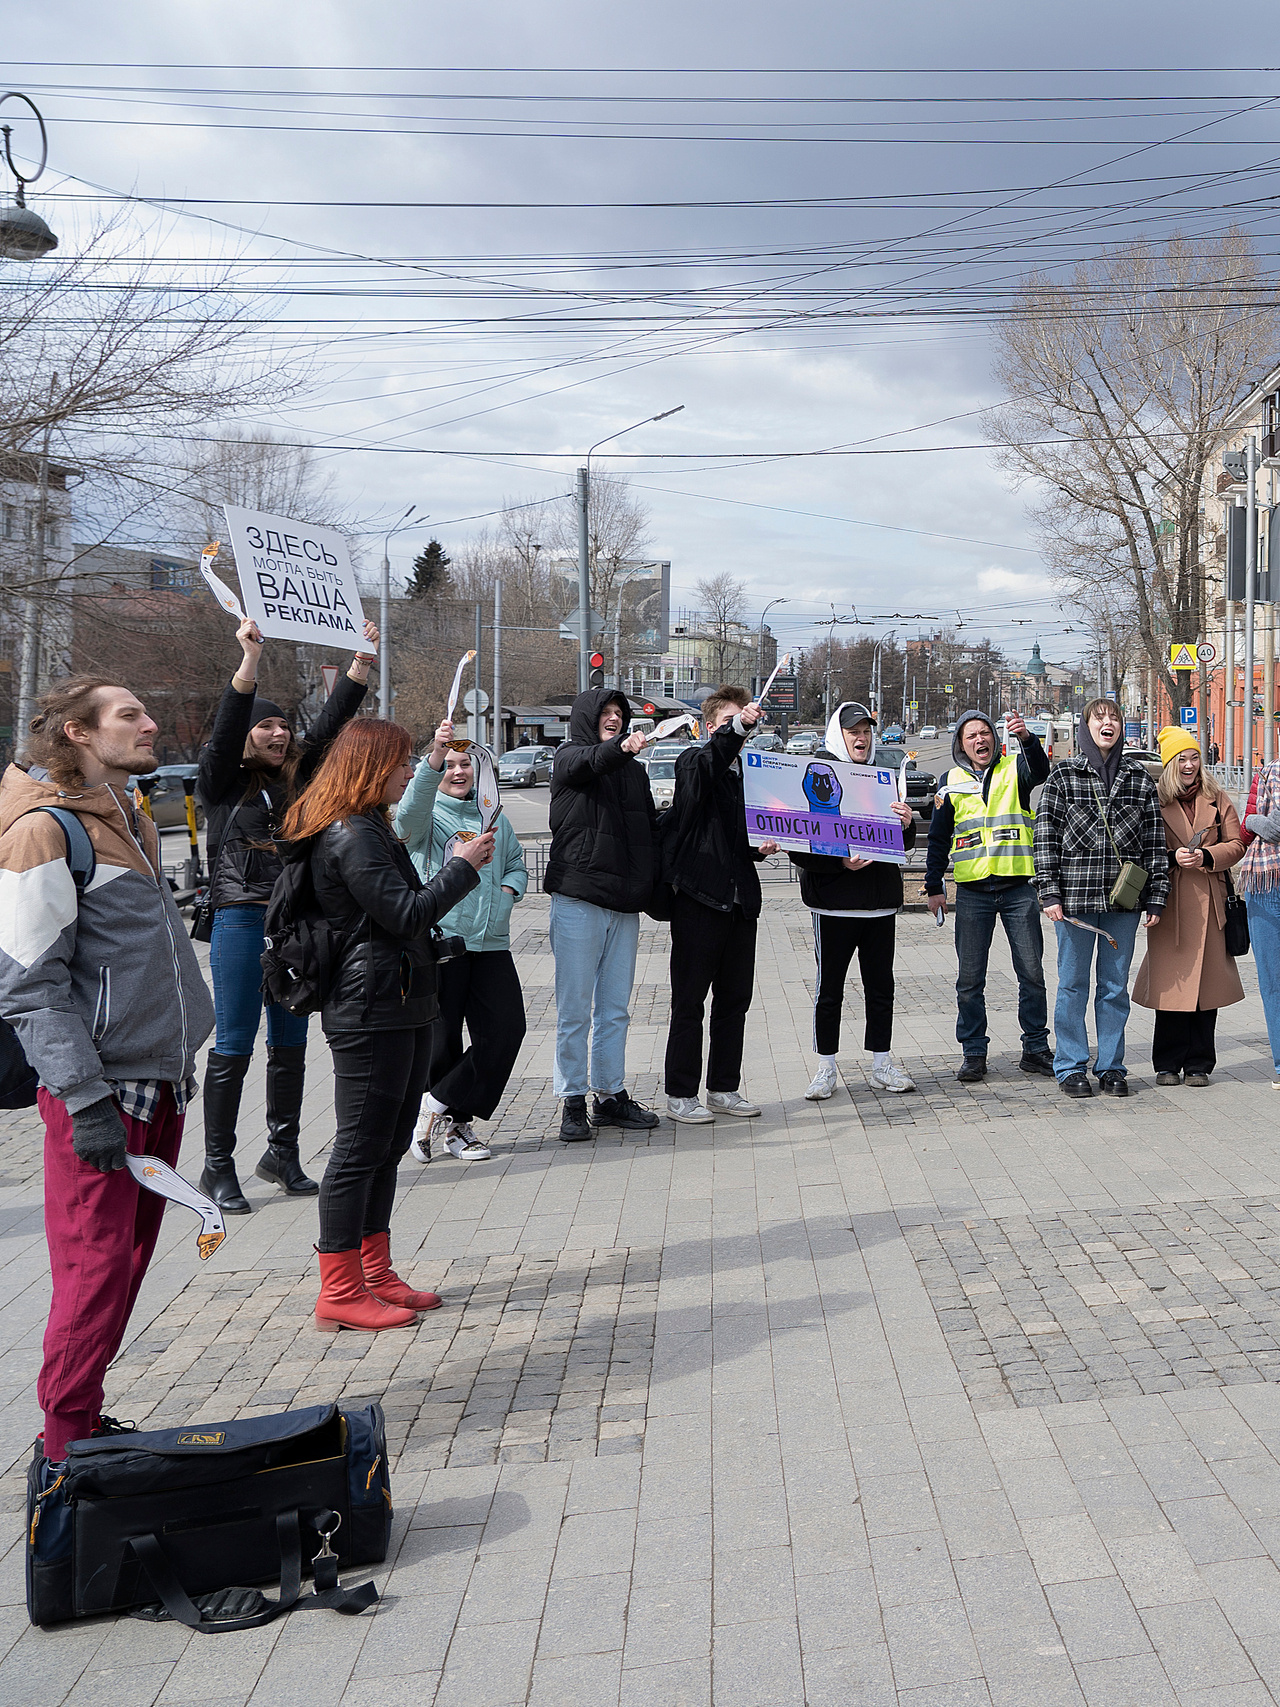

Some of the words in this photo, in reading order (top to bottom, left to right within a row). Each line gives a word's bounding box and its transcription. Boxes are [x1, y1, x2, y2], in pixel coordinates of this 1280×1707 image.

[246, 526, 338, 566] ЗДЕСЬ
[253, 556, 304, 576] МОГЛА
[306, 567, 343, 586] БЫТЬ
[256, 572, 353, 615] ВАША
[263, 603, 357, 633] РЕКЛАМА
[1185, 709, 1194, 722] P
[756, 814, 821, 836] ОТПУСТИ
[834, 823, 894, 845] ГУСЕЙ!!!
